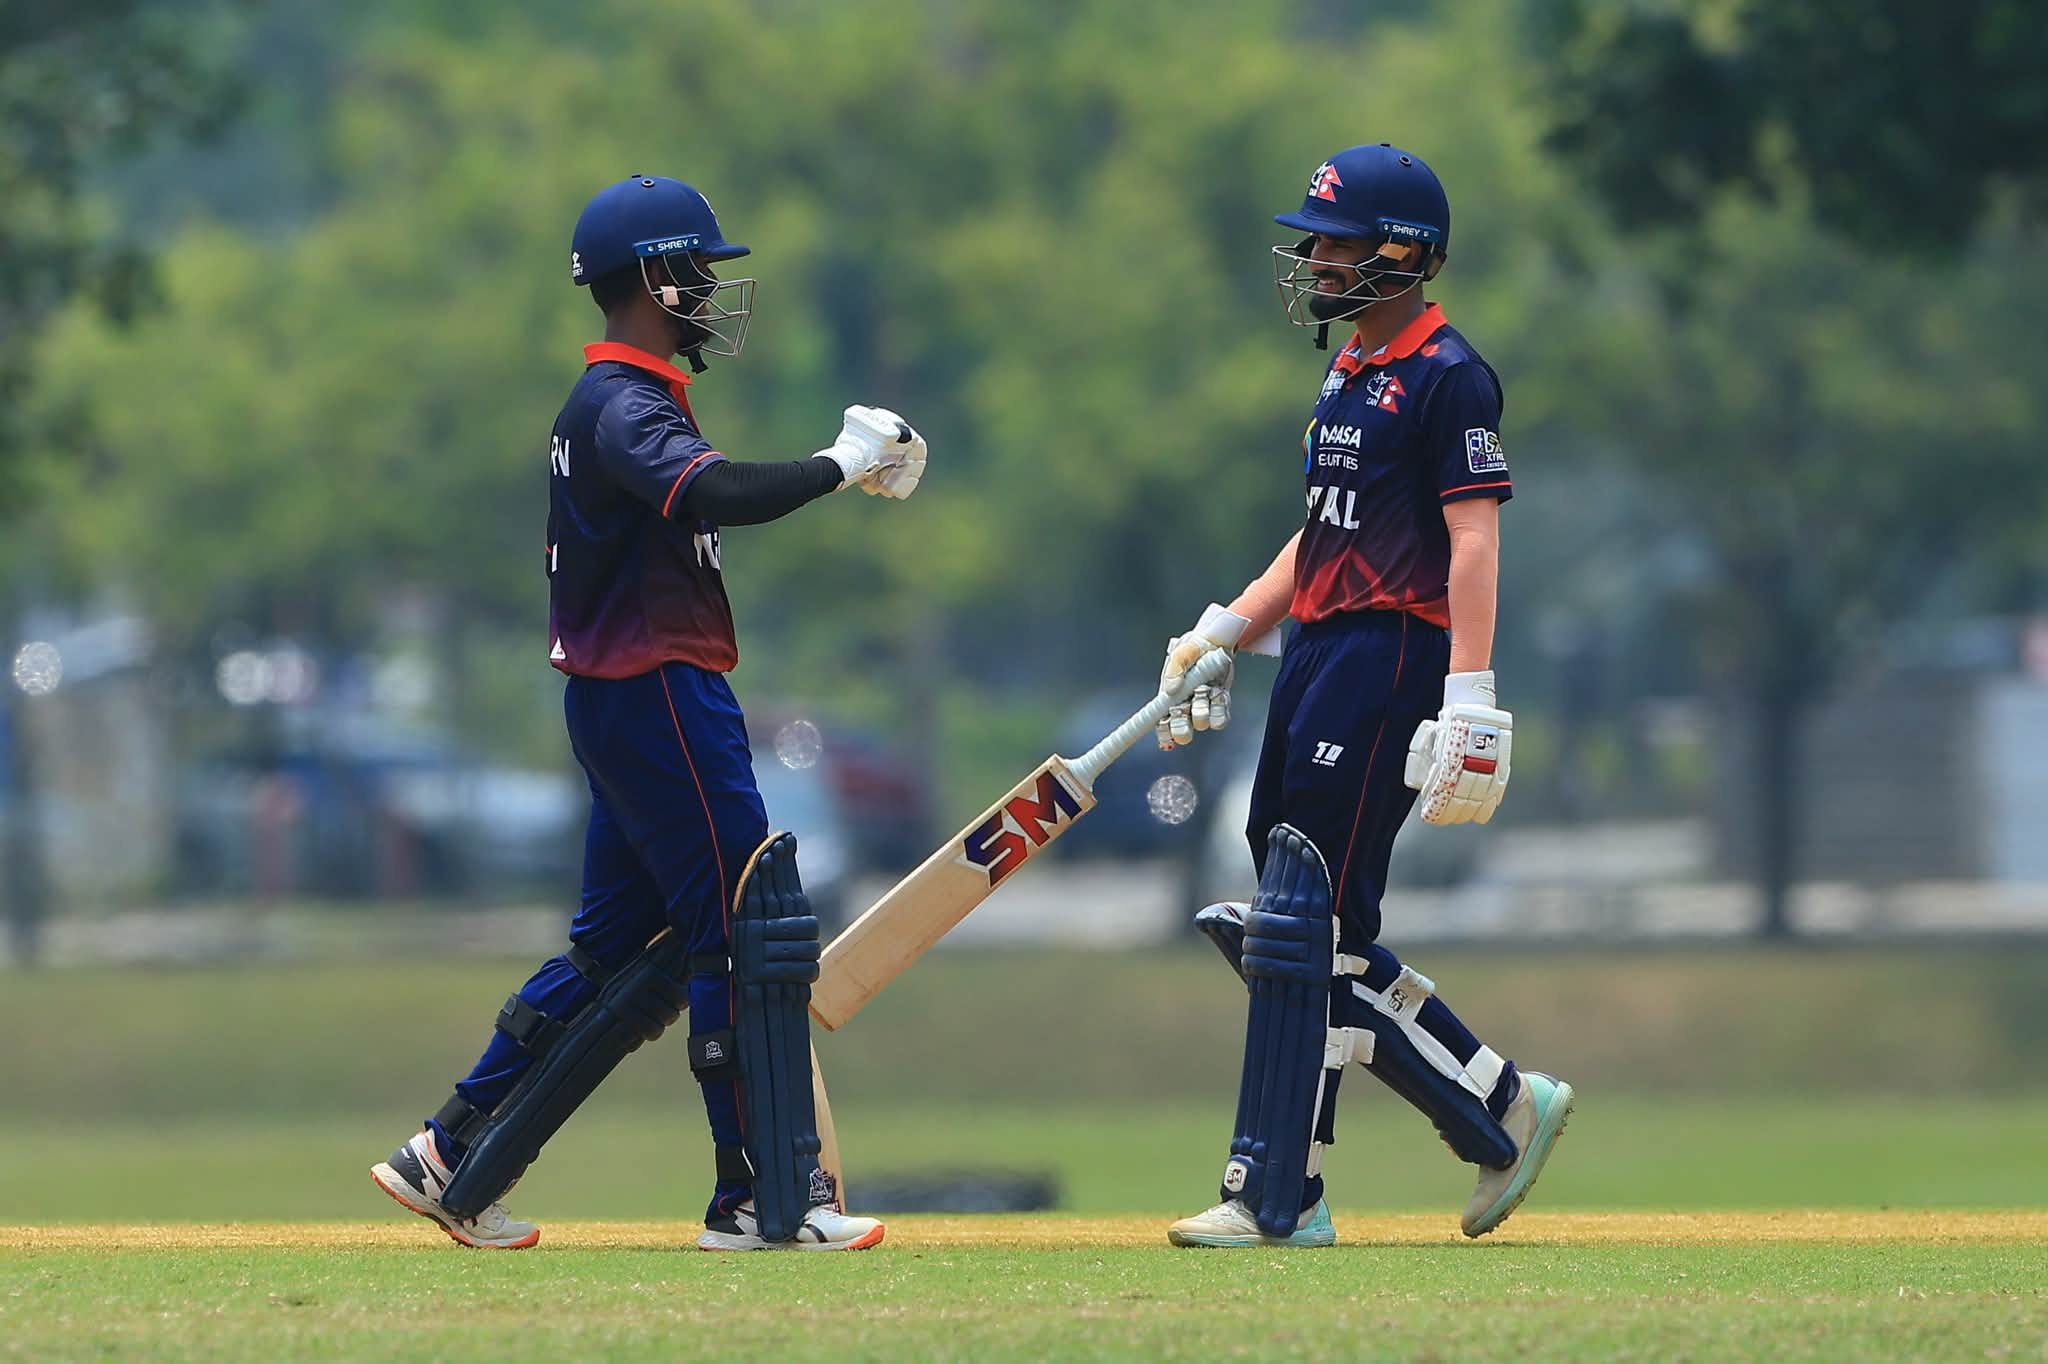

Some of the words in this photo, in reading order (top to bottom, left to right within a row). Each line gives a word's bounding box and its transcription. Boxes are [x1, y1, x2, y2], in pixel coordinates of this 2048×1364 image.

[1391, 224, 1421, 237] SHREY
[657, 239, 688, 251] SHREY
[1475, 735, 1497, 749] SM
[963, 769, 1083, 888] SM
